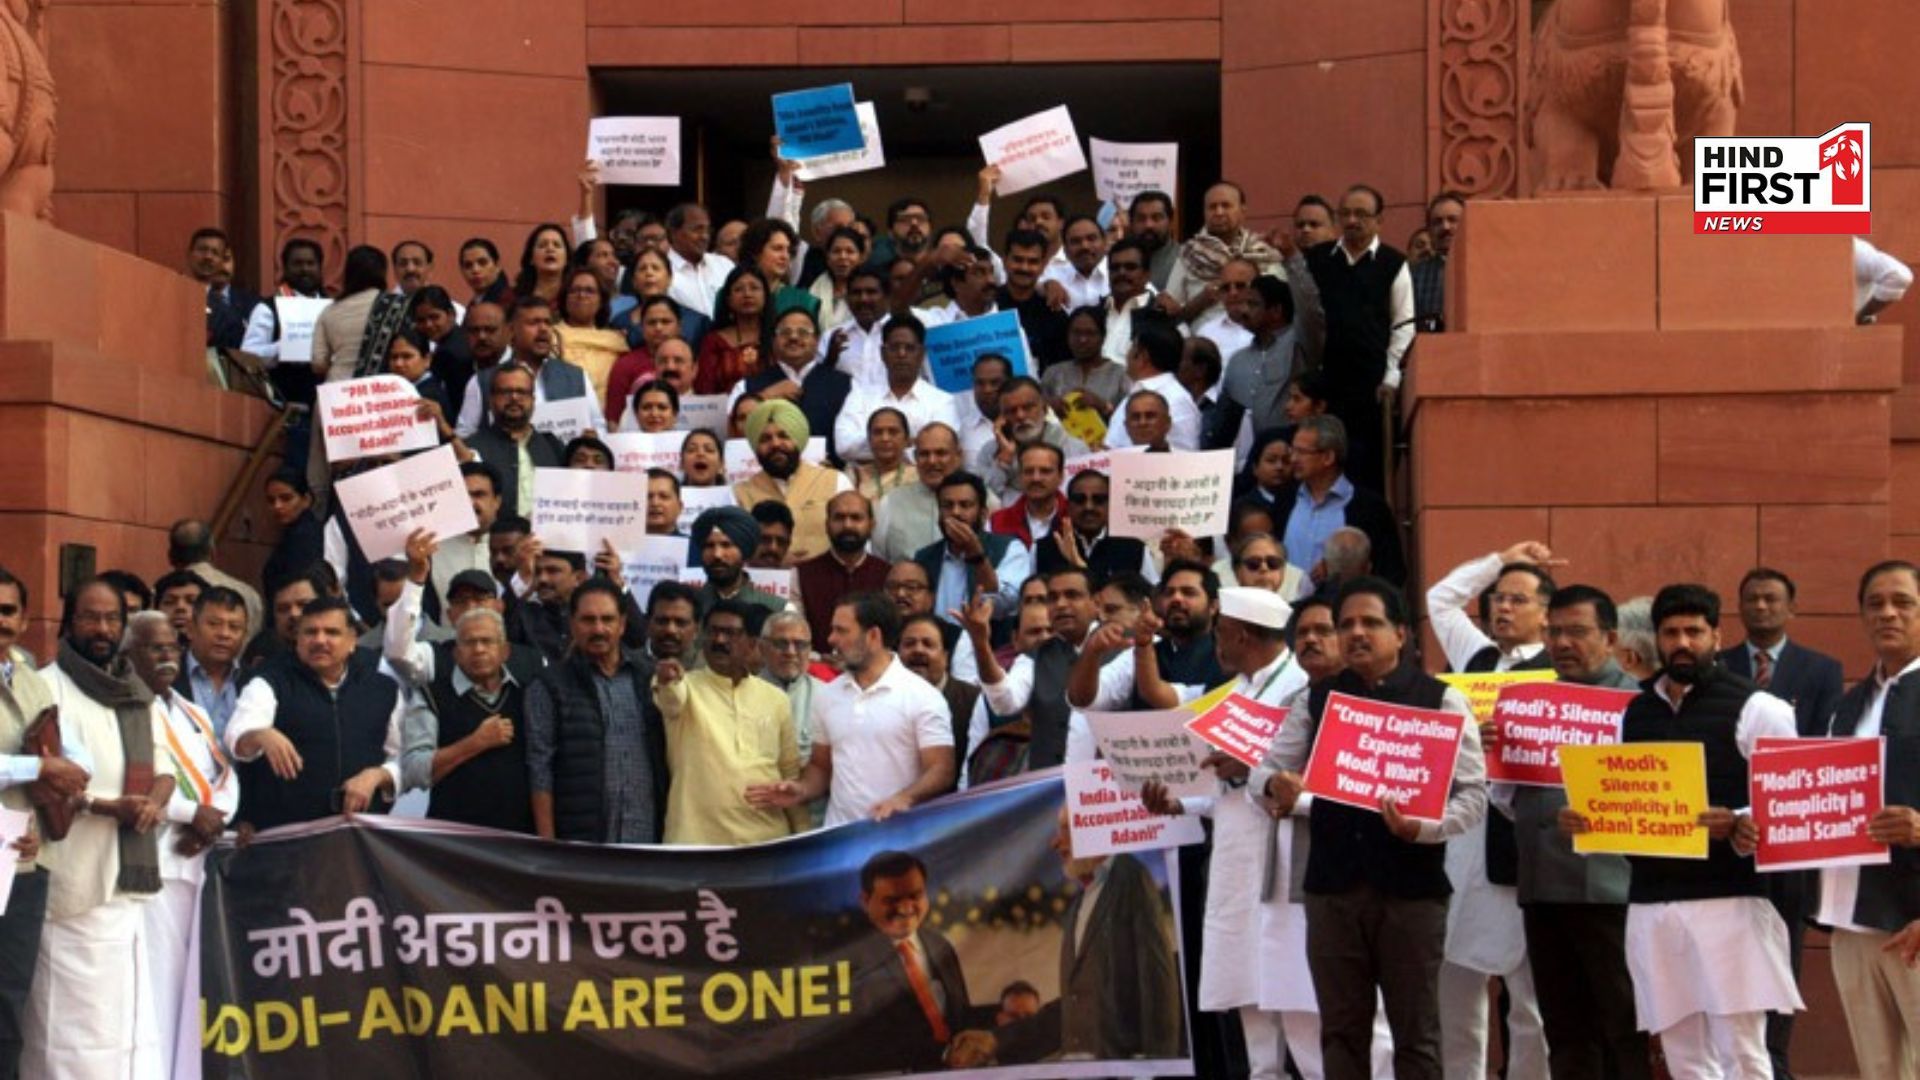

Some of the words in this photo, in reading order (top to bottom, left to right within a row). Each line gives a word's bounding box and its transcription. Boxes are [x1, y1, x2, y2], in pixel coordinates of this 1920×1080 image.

[331, 405, 363, 418] India
[366, 397, 419, 413] Demand
[328, 414, 414, 437] Accountability
[1224, 700, 1275, 734] "Modi's
[1498, 699, 1557, 720] "Modi's
[1332, 703, 1384, 734] "Crony
[1386, 715, 1458, 742] Capitalism
[1504, 720, 1593, 745] Complicity
[1598, 730, 1614, 745] in
[1208, 726, 1252, 754] Adani
[1357, 733, 1423, 760] Exposed:
[1502, 745, 1547, 766] Adani
[1598, 754, 1669, 773] "Modi's
[1092, 767, 1113, 781] "P
[1335, 751, 1381, 778] Modi,
[1384, 762, 1432, 785] What's
[1753, 768, 1814, 792] "Modi's
[1816, 764, 1868, 787] Silence
[1079, 788, 1116, 806] India
[1336, 773, 1375, 797] Your
[1600, 777, 1660, 794] Silence
[1587, 799, 1670, 818] Complicity
[1674, 798, 1689, 815] in
[1768, 793, 1848, 819] Complicity
[1850, 788, 1866, 809] in
[1073, 805, 1161, 828] Accountab
[1767, 820, 1810, 845] Adani
[1814, 814, 1867, 841] Scam?"
[248, 897, 384, 979] मोदी
[393, 896, 573, 968] अडानी
[582, 911, 687, 960] एक
[697, 889, 740, 963] है
[563, 975, 685, 1032] ARE
[701, 960, 851, 1024] ONE!
